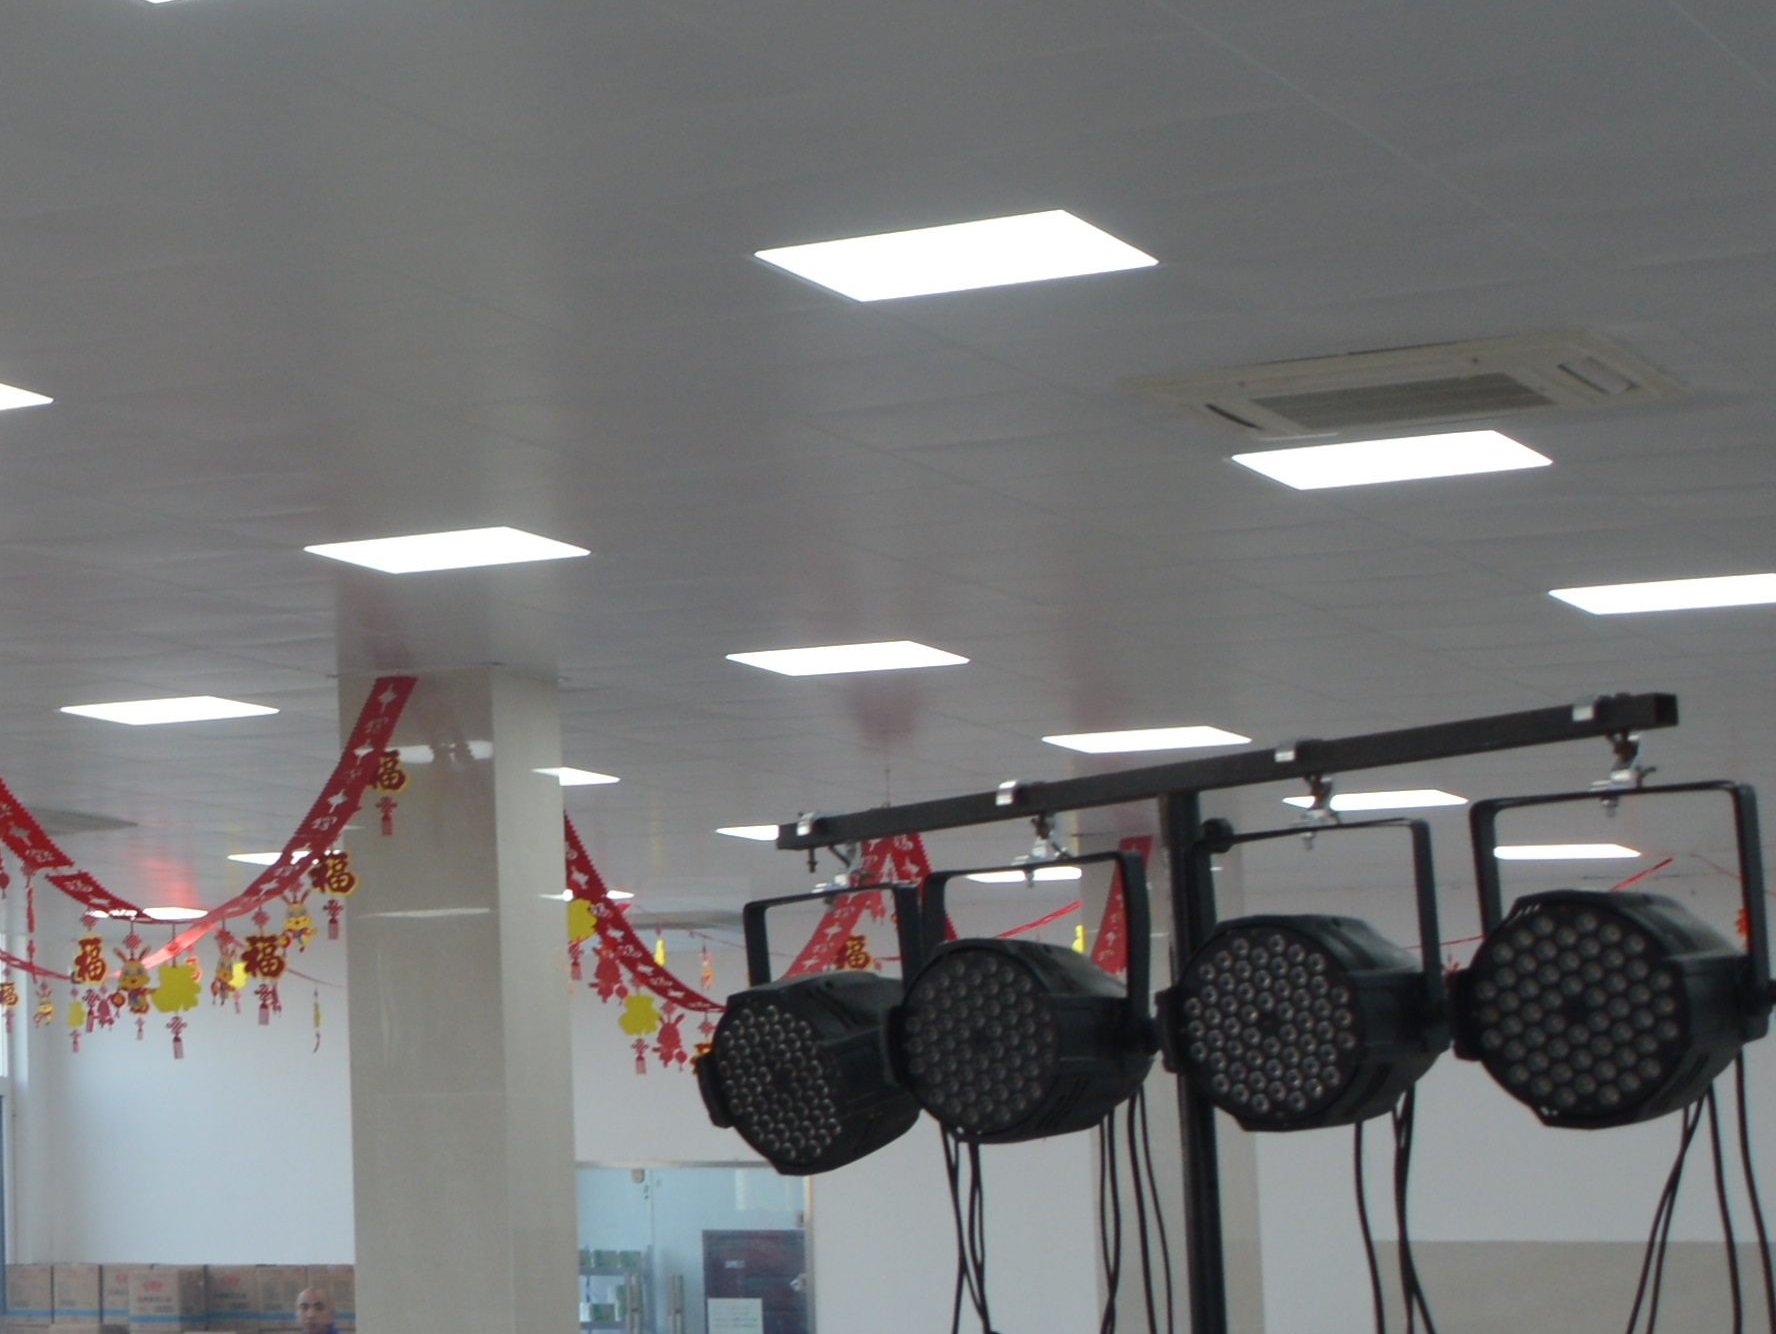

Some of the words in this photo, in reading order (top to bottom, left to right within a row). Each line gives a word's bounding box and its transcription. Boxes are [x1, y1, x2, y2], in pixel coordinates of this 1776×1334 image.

[309, 850, 357, 894] 福
[75, 937, 107, 983] 福
[242, 934, 287, 979] 福
